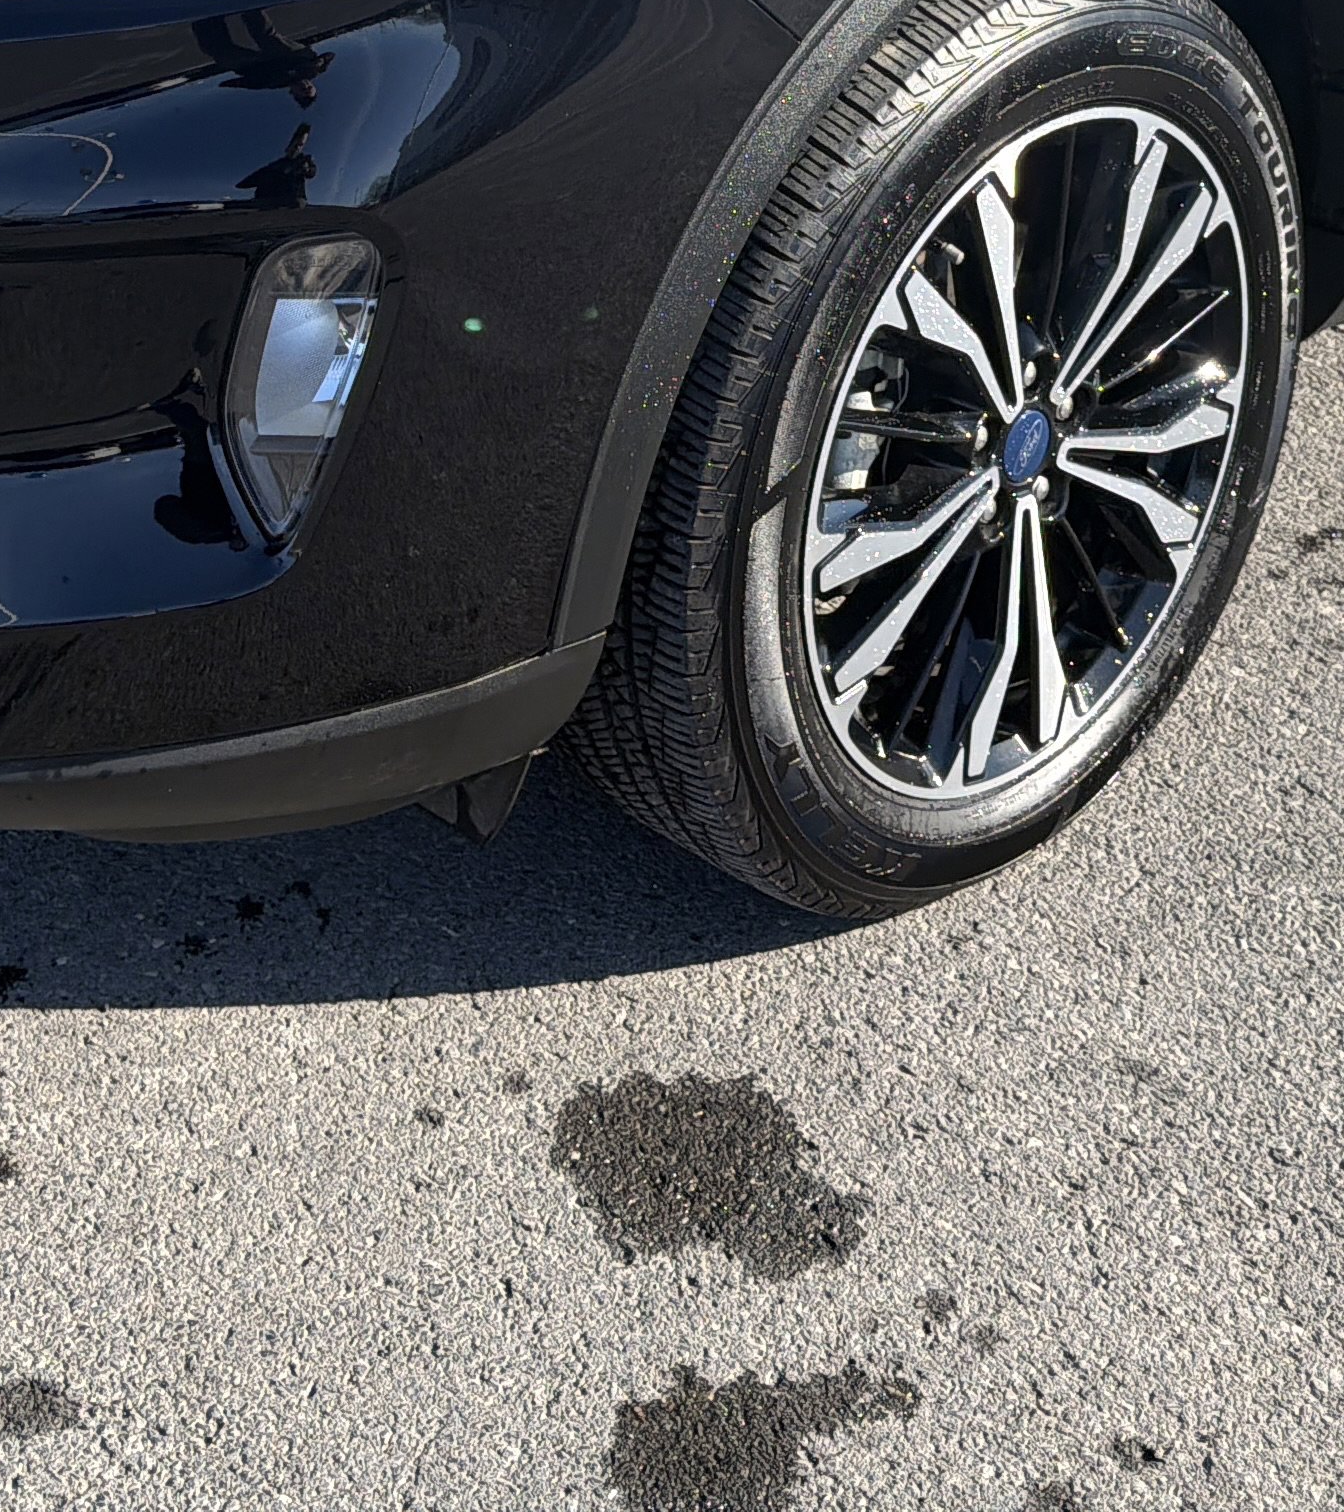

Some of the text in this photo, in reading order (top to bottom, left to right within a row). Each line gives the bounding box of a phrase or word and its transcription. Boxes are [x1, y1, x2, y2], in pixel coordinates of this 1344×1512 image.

[1115, 30, 1232, 88] EDGE
[1238, 85, 1299, 341] TOURING
[763, 732, 924, 882] KELLY
